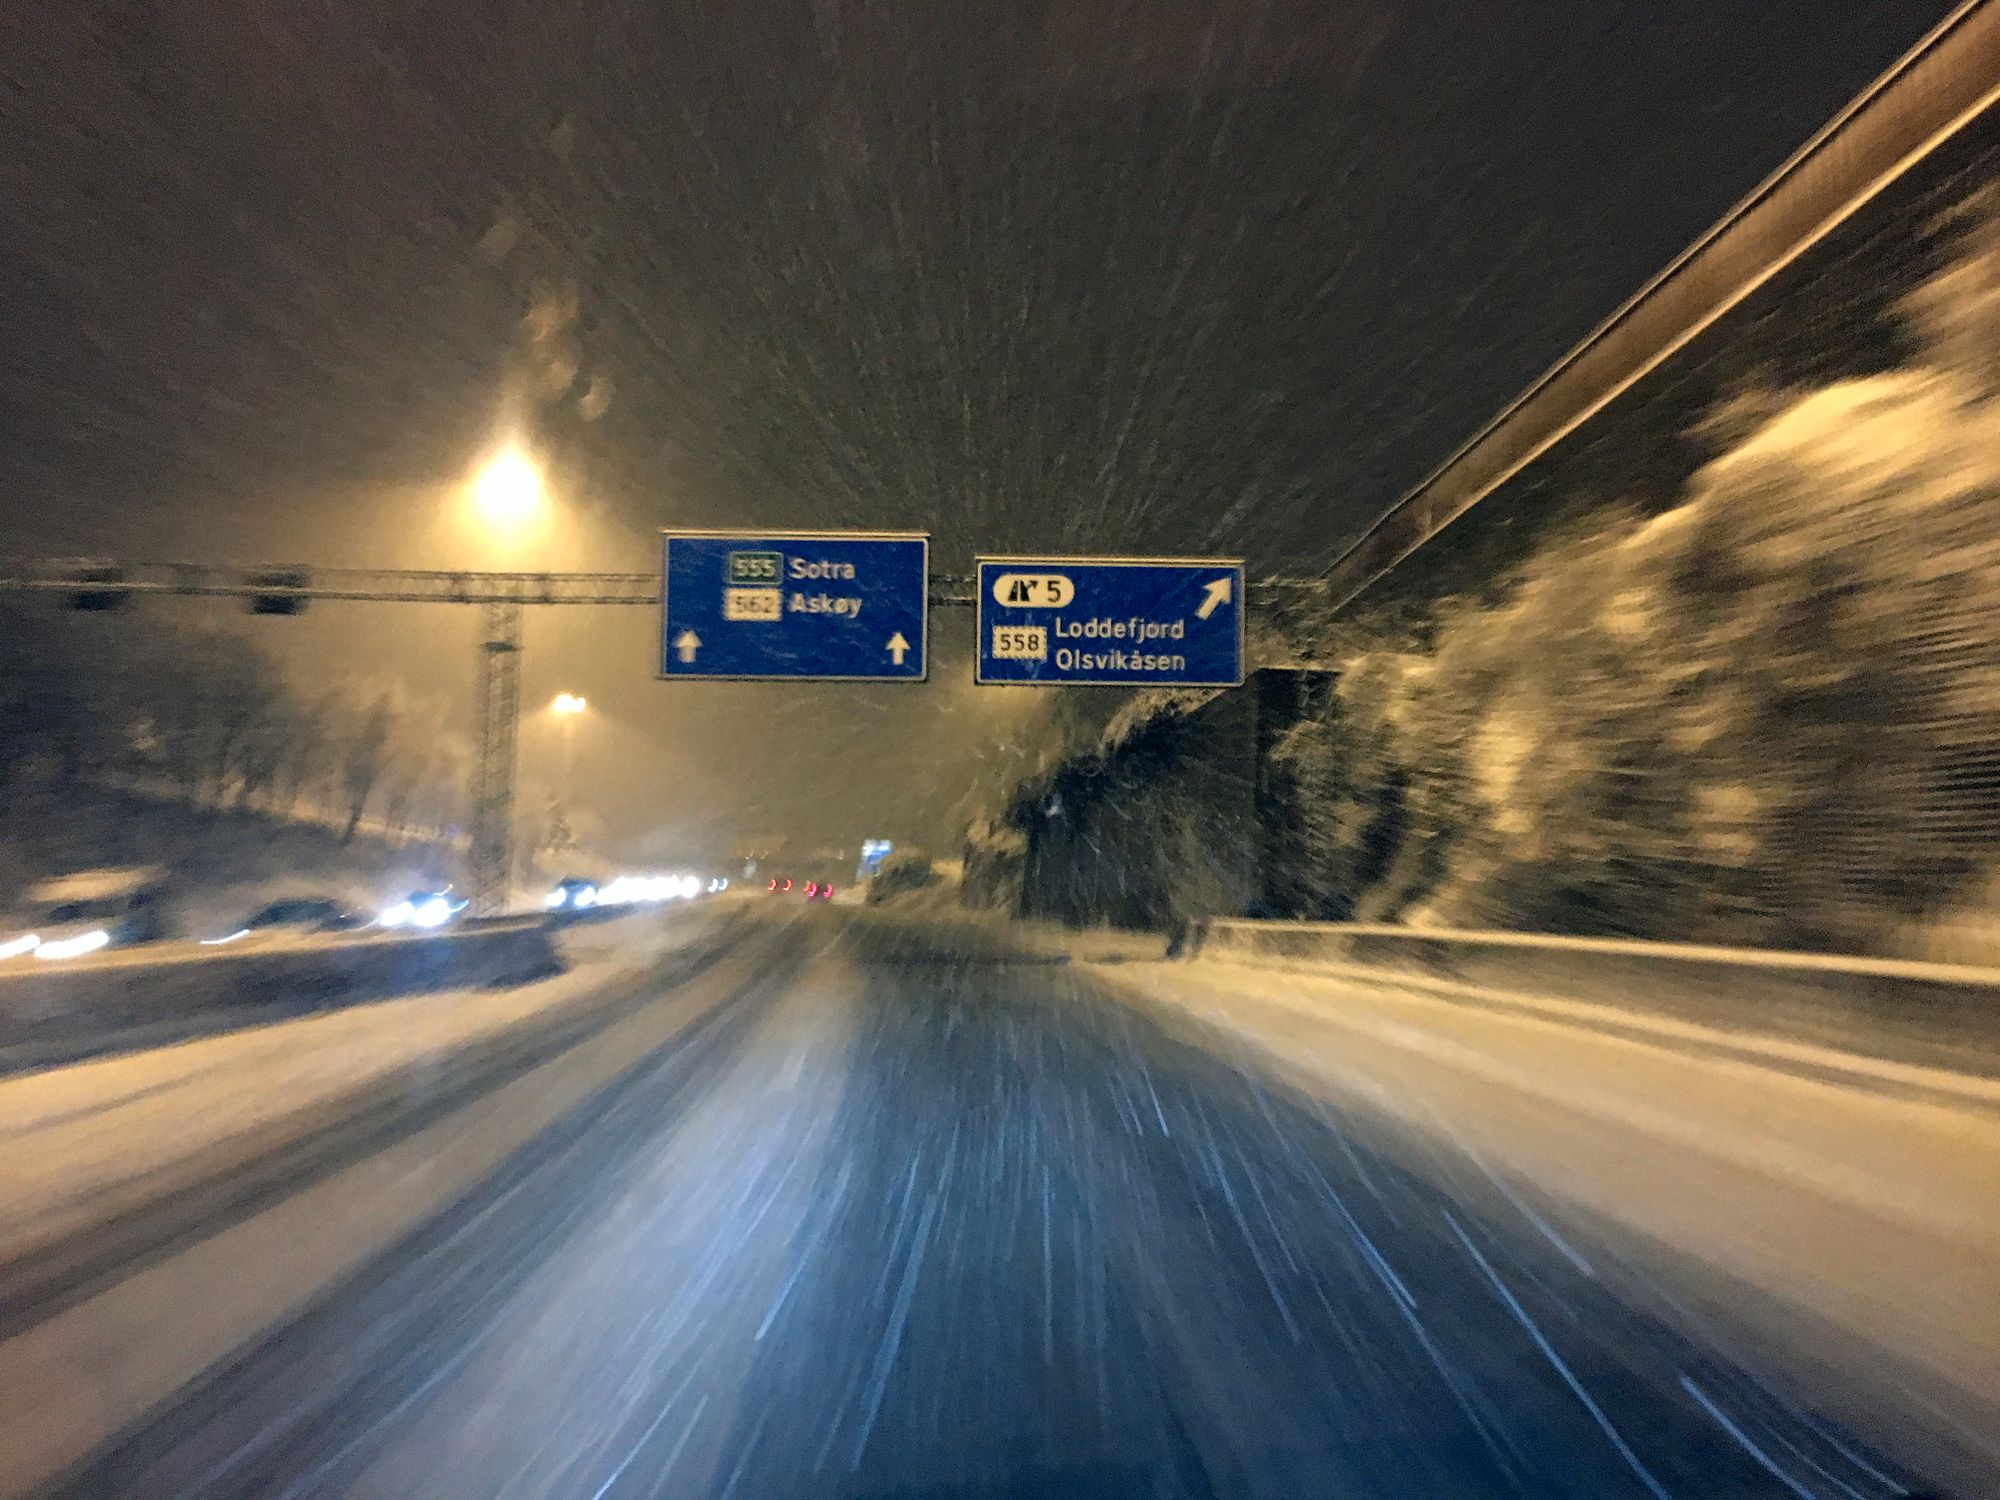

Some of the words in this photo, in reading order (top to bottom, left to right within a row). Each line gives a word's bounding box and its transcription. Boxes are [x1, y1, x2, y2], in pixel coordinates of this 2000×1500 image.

[788, 557, 856, 579] Sotra
[1047, 580, 1062, 602] 5
[789, 593, 862, 618] Askøy
[1055, 617, 1184, 643] Loddefjord
[1000, 634, 1040, 651] 558
[1055, 648, 1186, 671] Olsvikåsen
